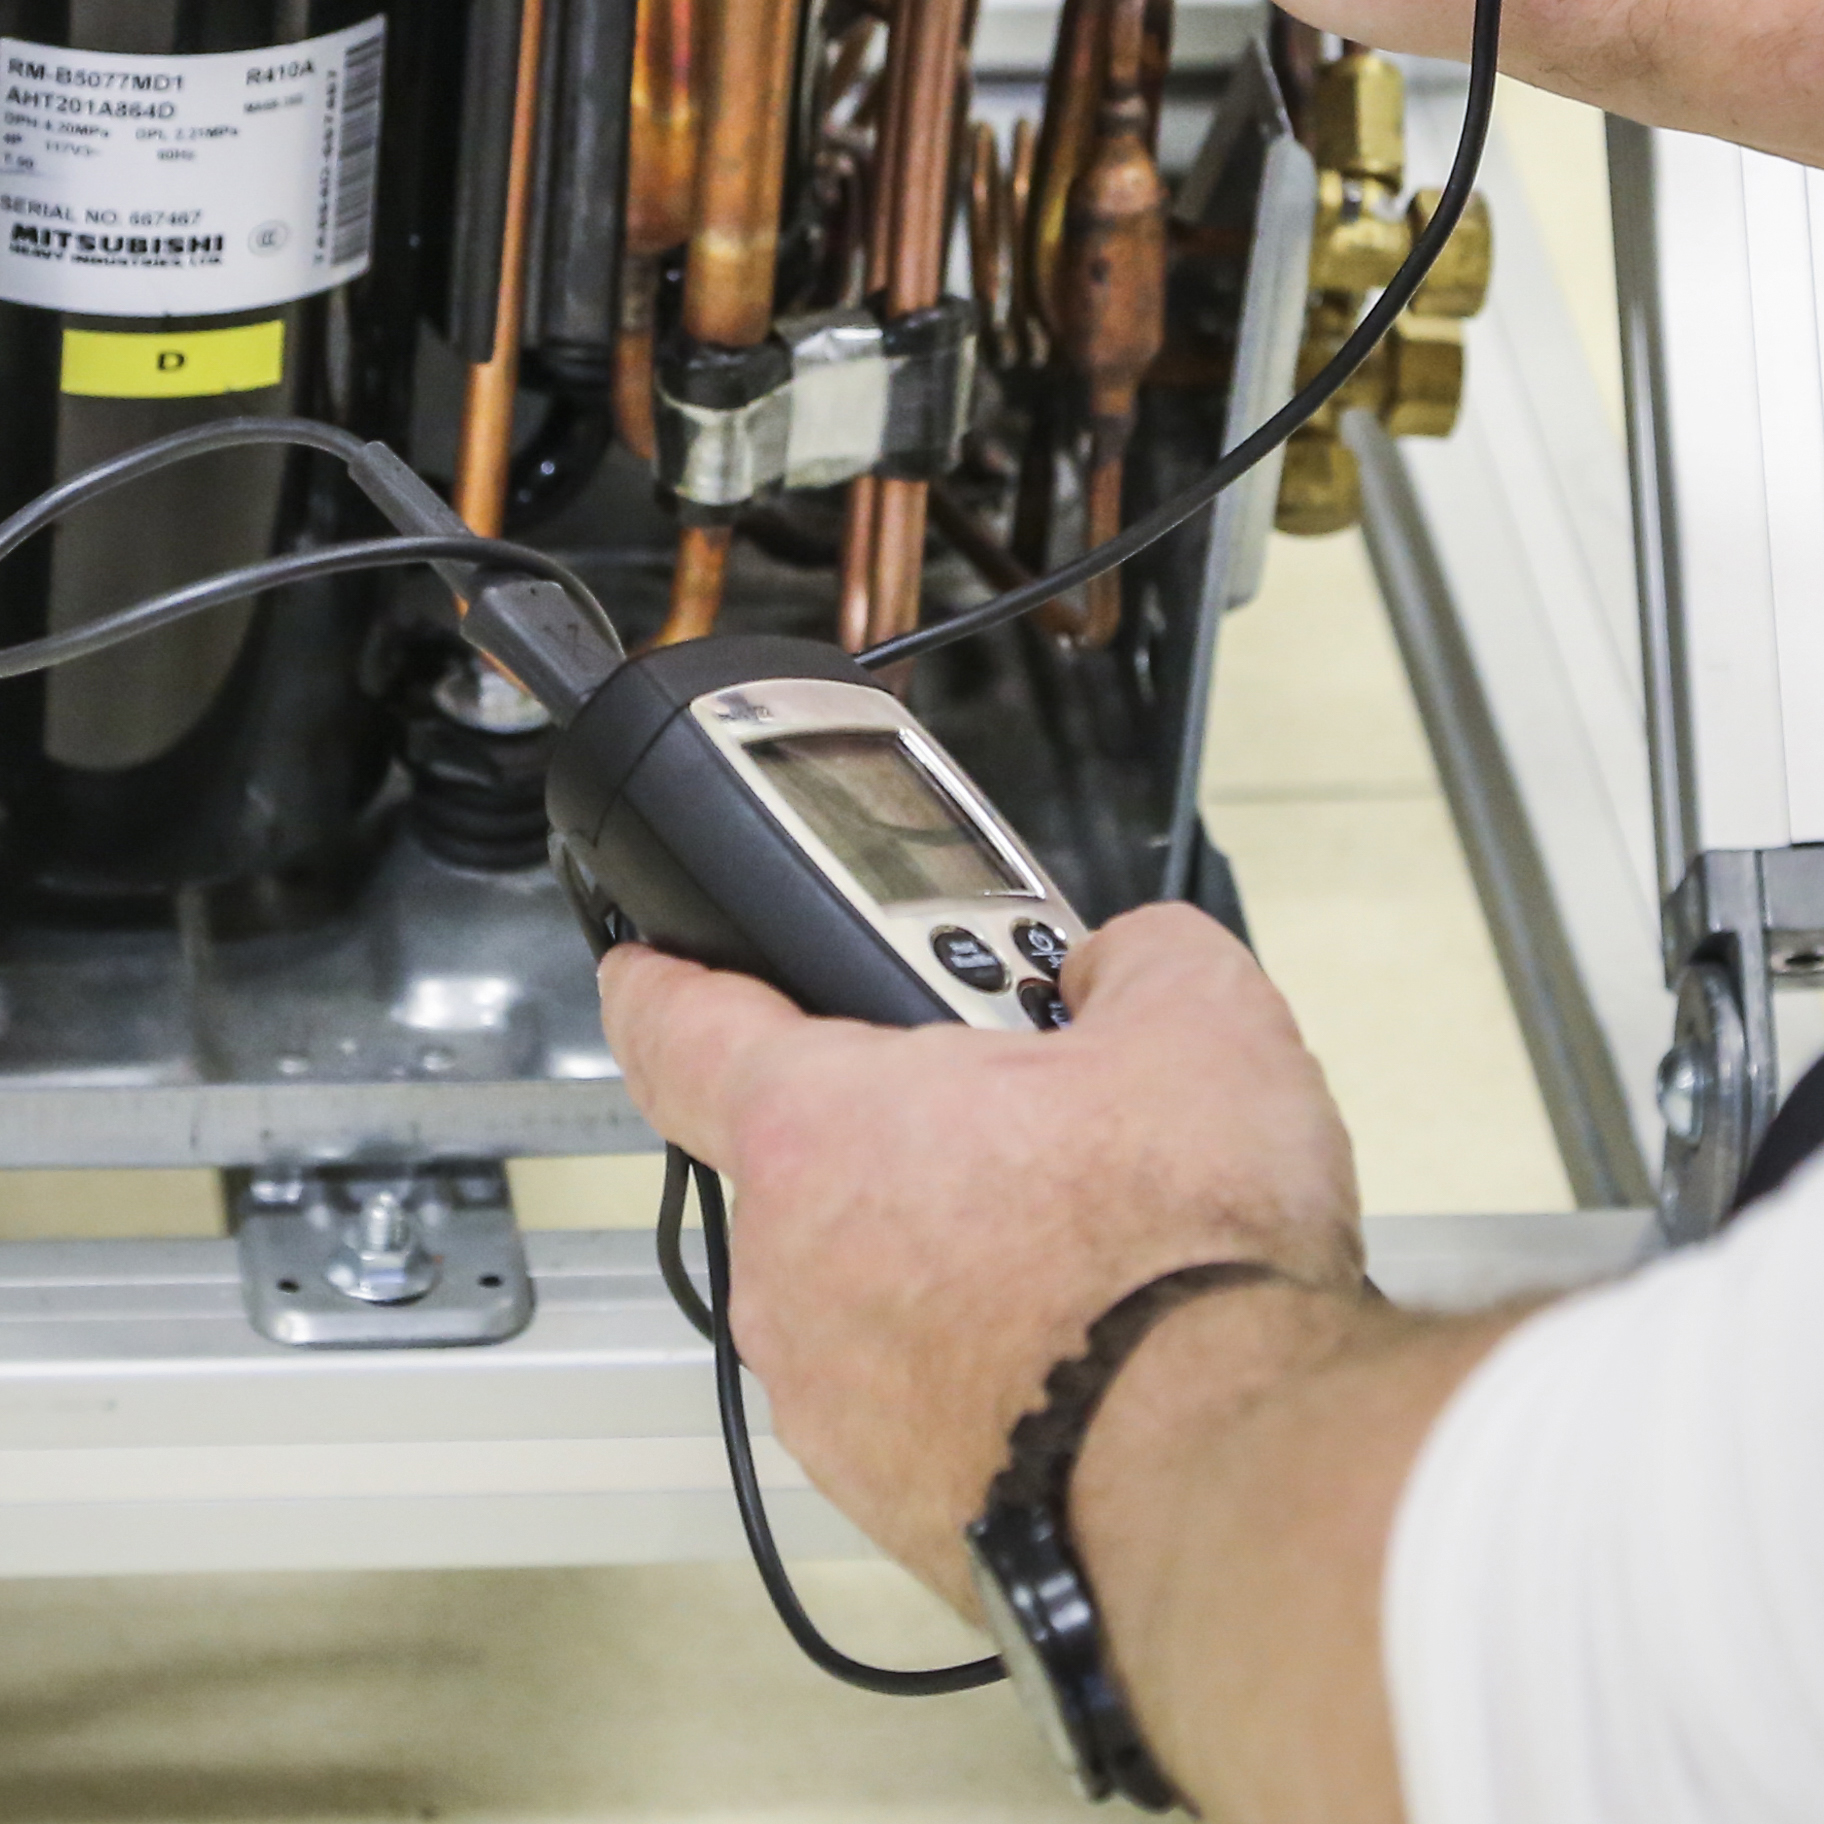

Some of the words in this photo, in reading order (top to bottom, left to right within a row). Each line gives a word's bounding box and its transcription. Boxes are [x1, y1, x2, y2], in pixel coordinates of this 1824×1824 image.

[245, 59, 316, 87] R410A
[0, 194, 74, 222] SERIAL
[11, 223, 225, 254] MITSUBISHI
[158, 351, 186, 371] D
